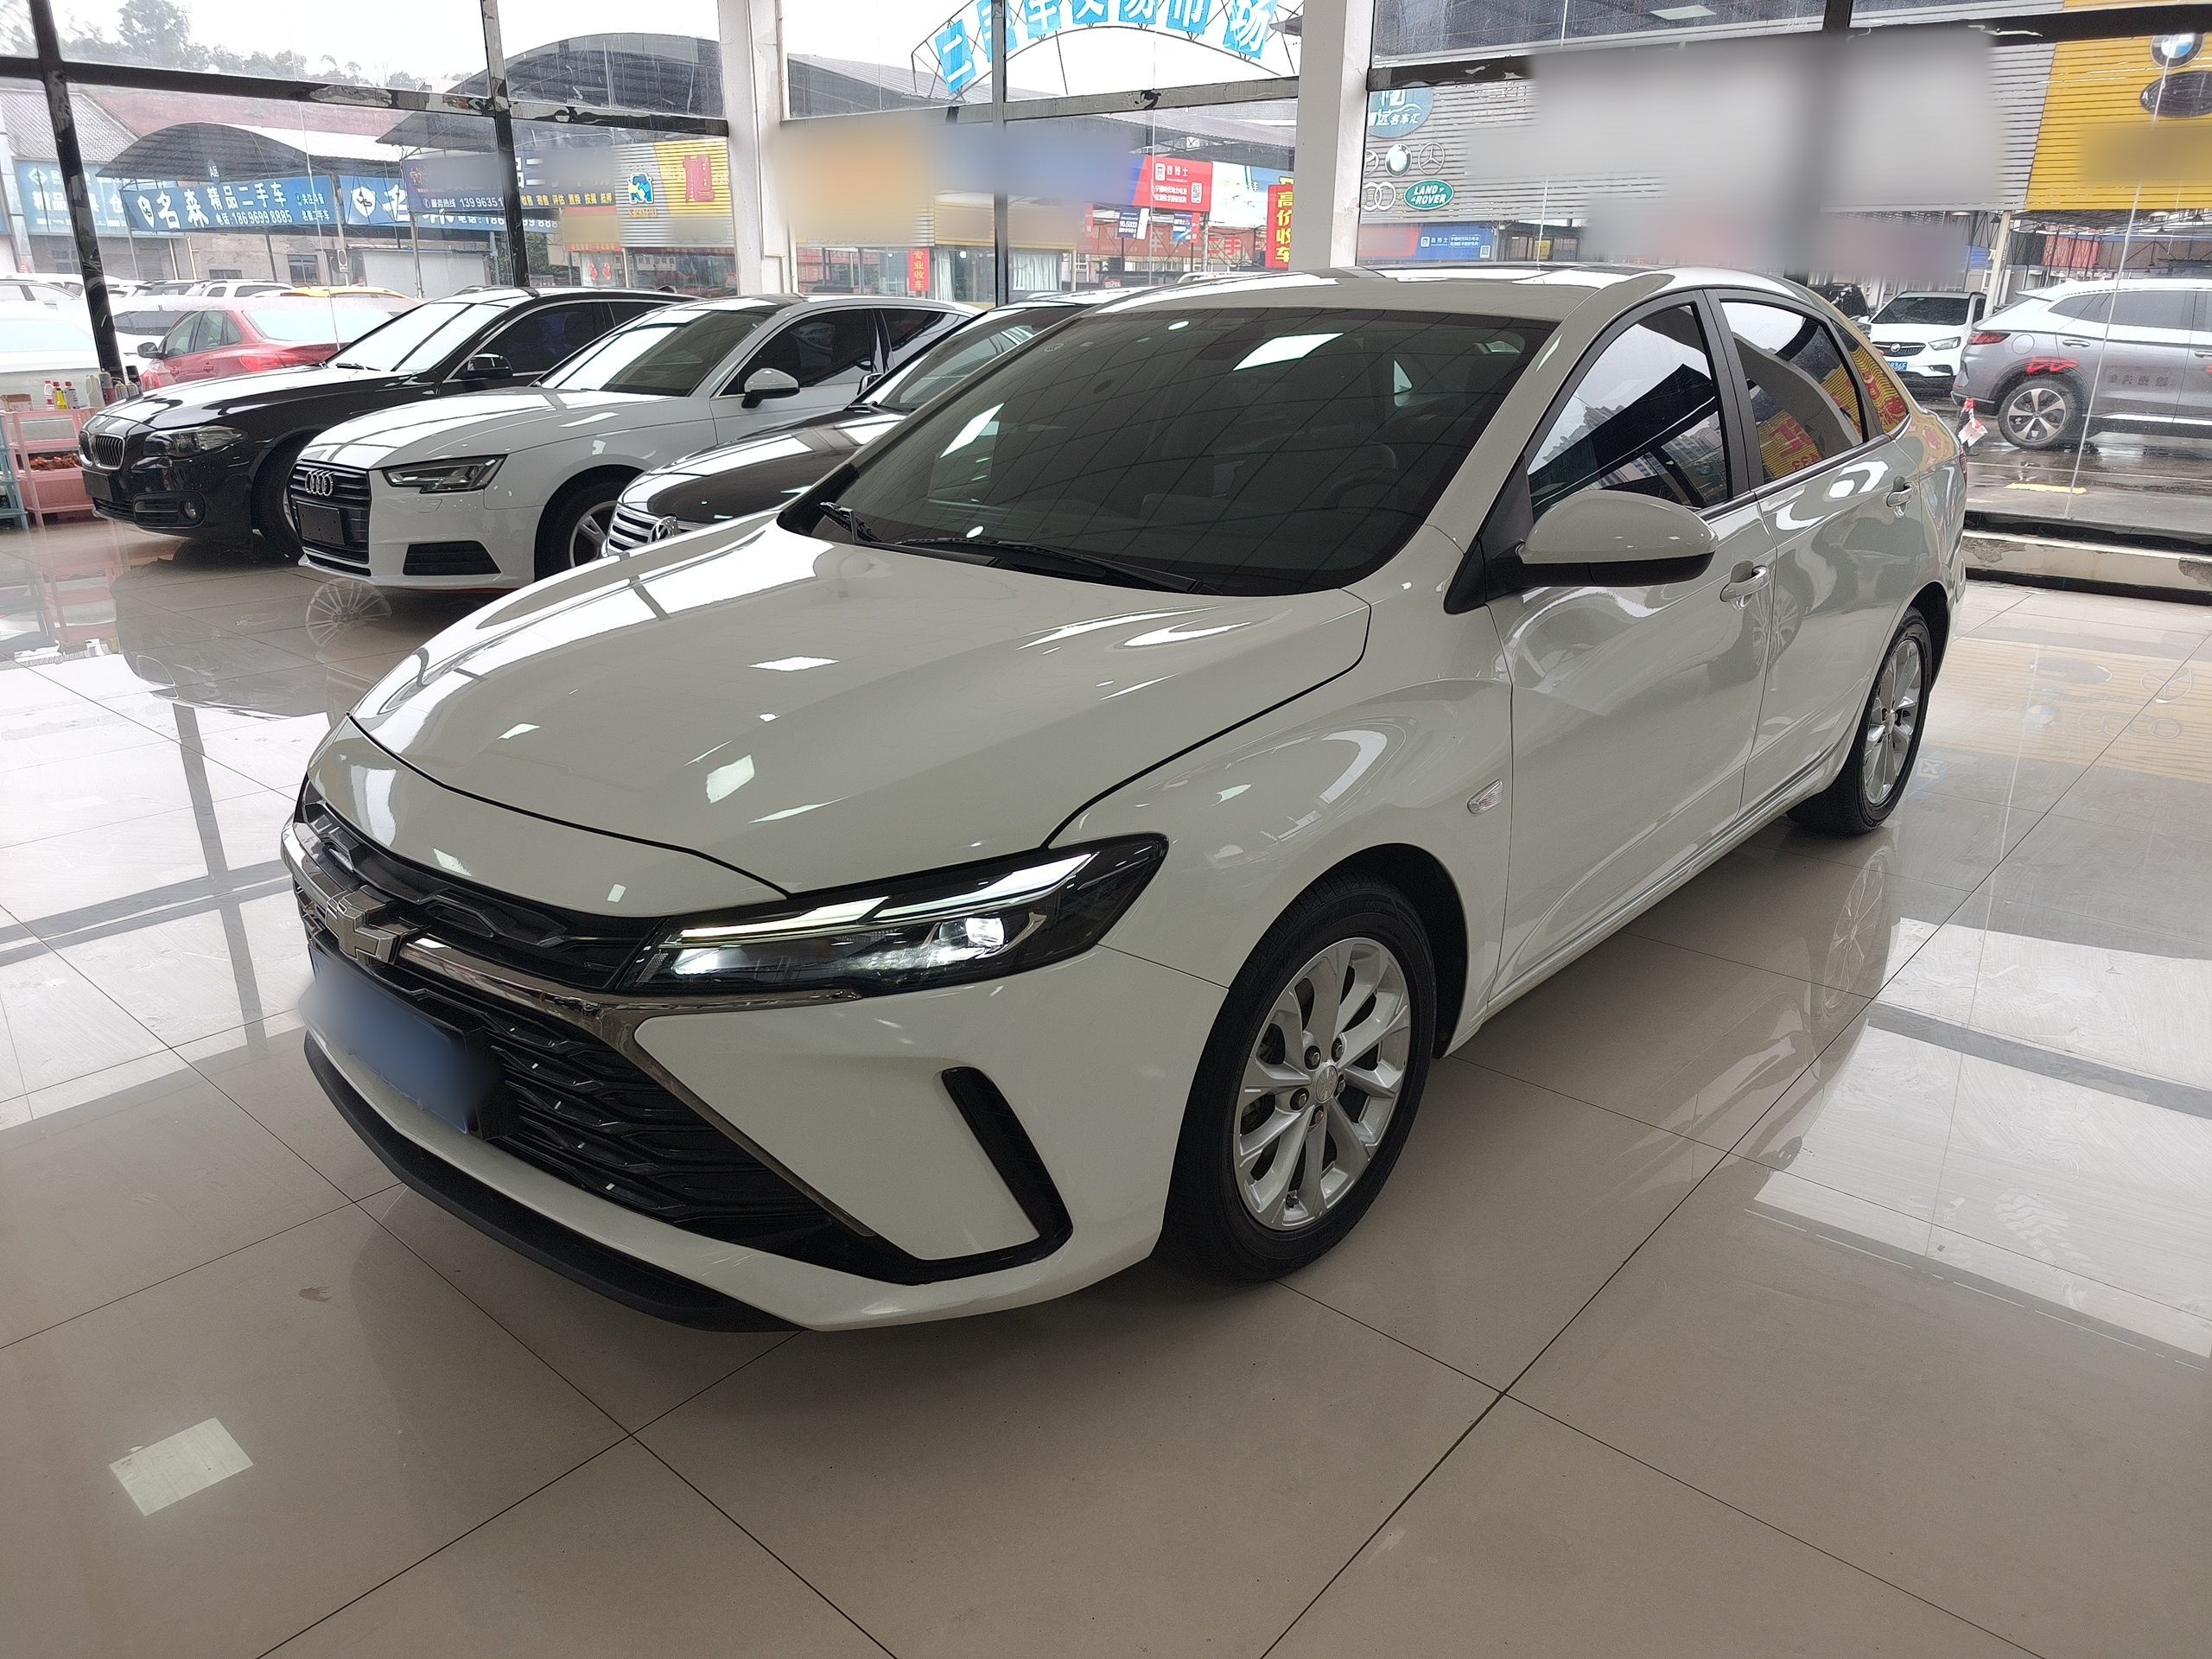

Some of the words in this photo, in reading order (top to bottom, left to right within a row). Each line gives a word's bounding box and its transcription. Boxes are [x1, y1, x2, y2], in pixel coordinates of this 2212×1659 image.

[683, 155, 716, 204] 旭
[1413, 184, 1439, 196] LAND
[156, 190, 210, 230] 名森
[206, 181, 288, 212] 精品二手车
[430, 198, 456, 208] 服务热线
[459, 198, 475, 208] 139
[476, 197, 498, 207] 9635
[1414, 194, 1447, 206] ROVER
[247, 210, 270, 226] 9699
[270, 209, 293, 225] 8885
[912, 250, 925, 290] 专业收车
